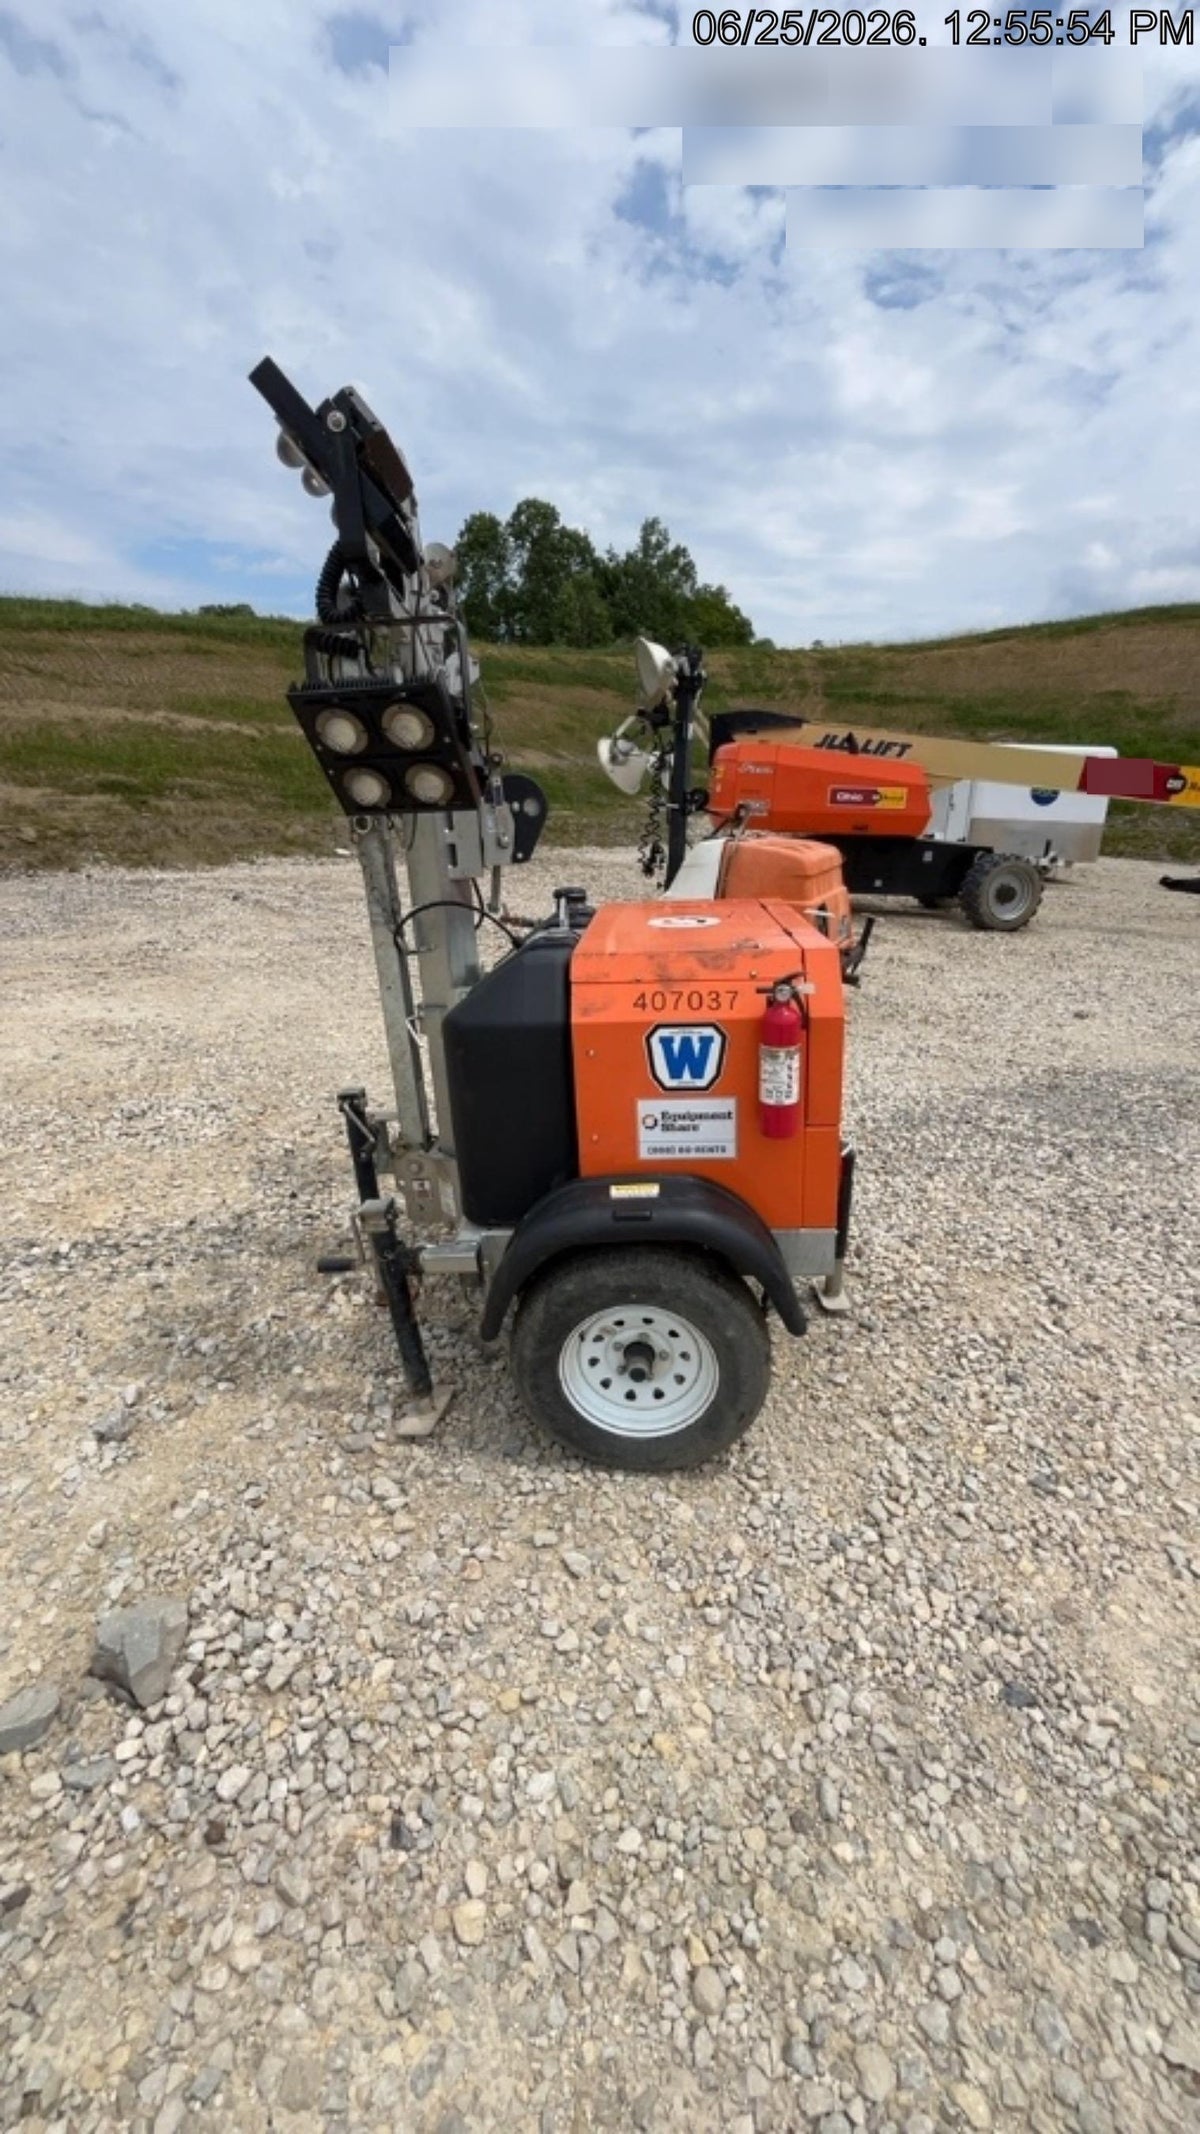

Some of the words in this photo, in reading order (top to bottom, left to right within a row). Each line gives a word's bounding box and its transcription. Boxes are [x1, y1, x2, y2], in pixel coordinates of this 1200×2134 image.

[860, 738, 913, 758] LIFT
[633, 990, 739, 1012] 407037
[659, 1036, 714, 1079] W
[661, 1110, 733, 1122] Equipment
[661, 1123, 700, 1132] Share
